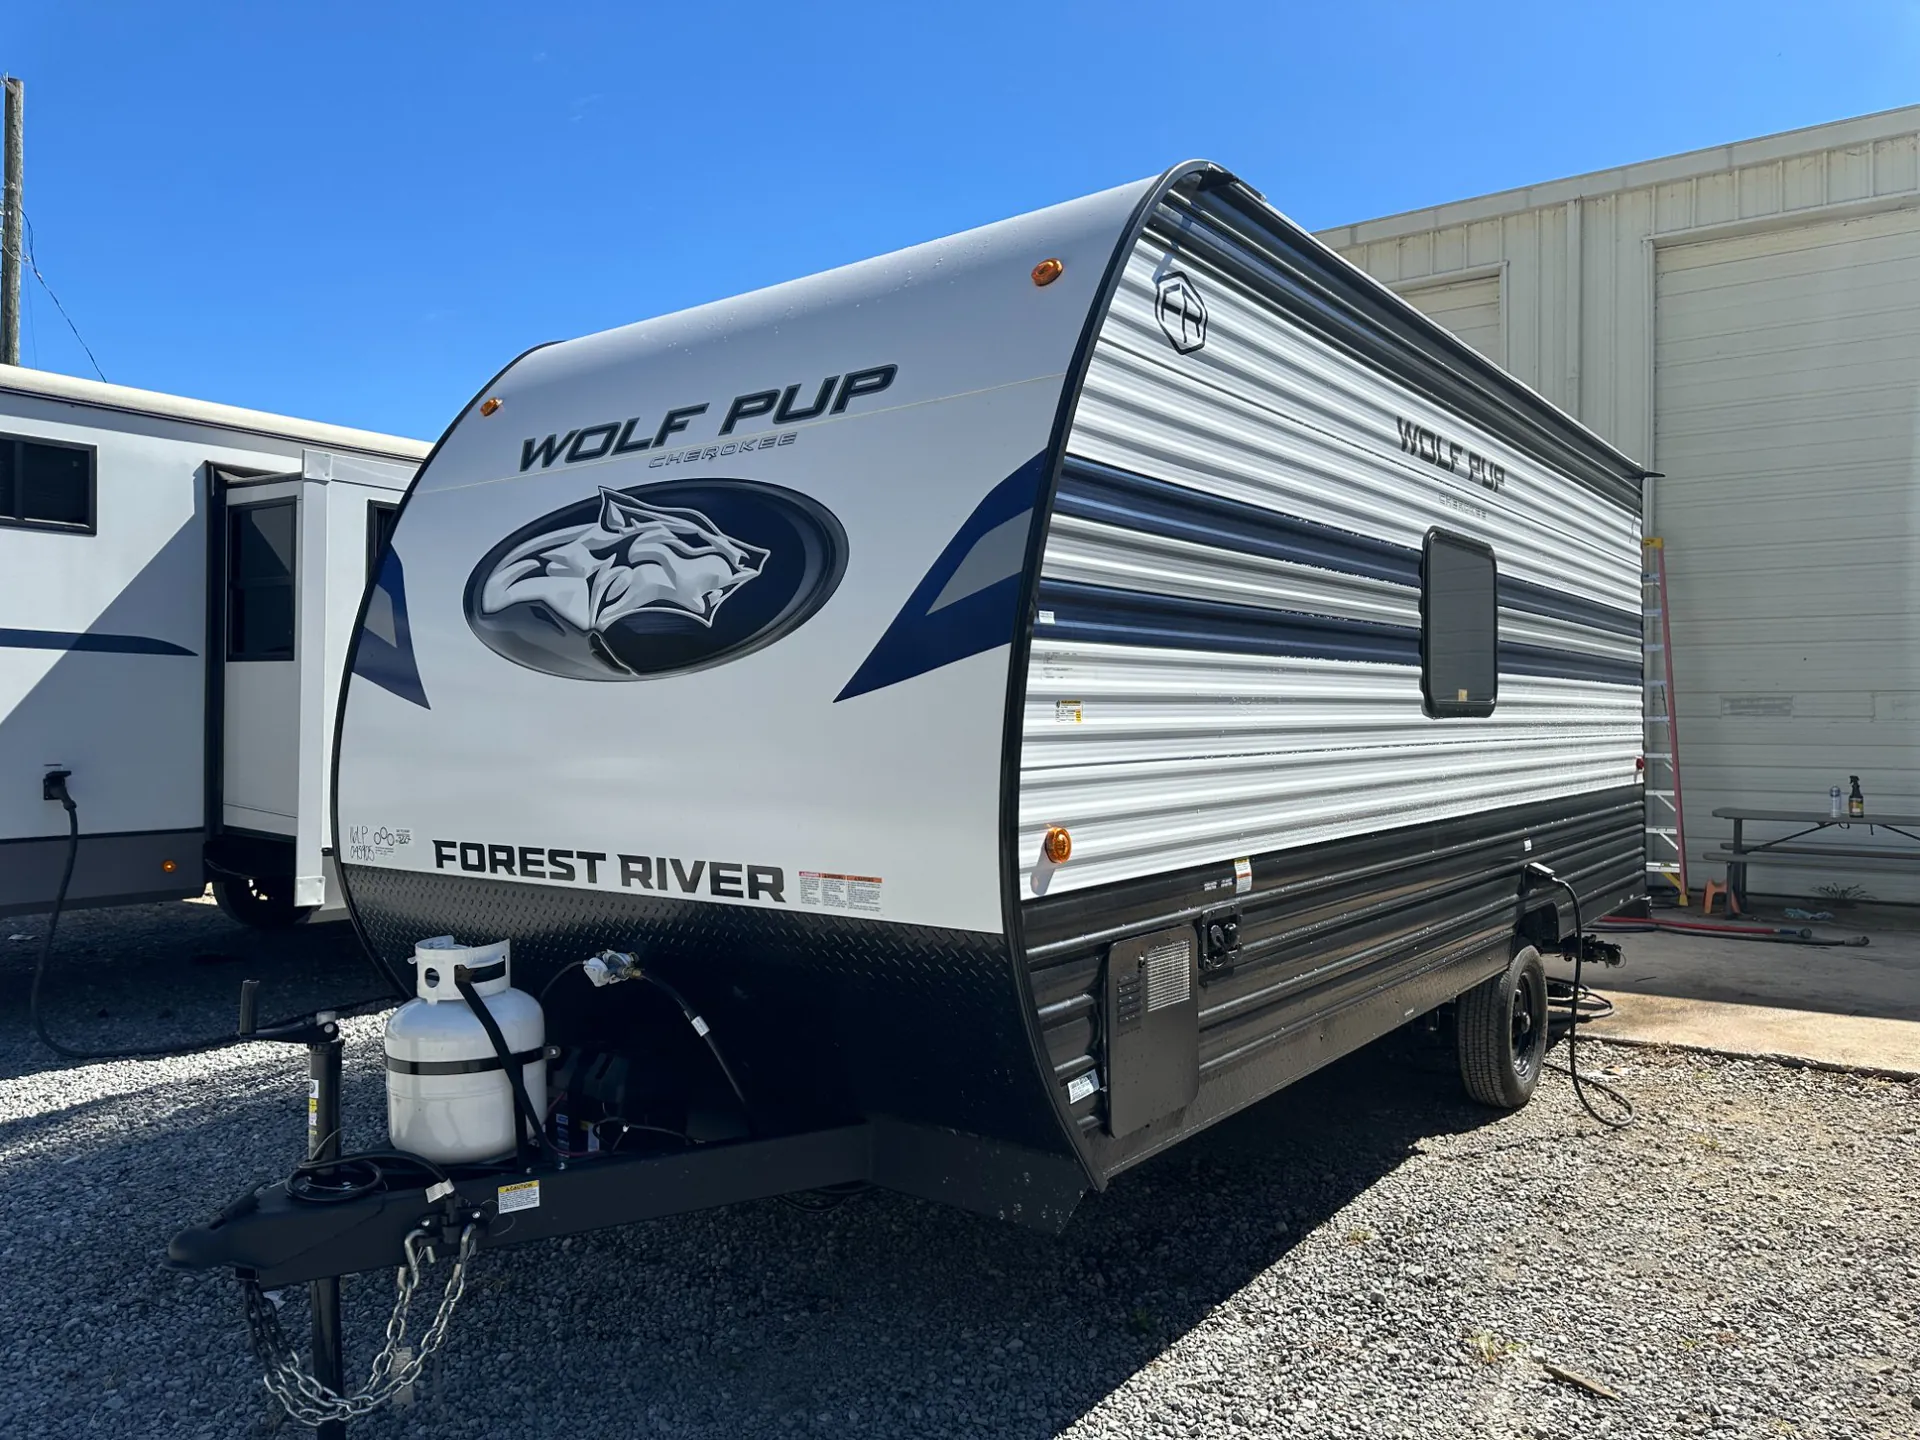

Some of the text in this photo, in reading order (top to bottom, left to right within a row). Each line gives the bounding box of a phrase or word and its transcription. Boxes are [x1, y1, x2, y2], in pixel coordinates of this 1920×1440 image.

[519, 364, 899, 472] WOLF PUP
[648, 431, 798, 469] CHEROKEE
[1396, 415, 1505, 493] WOLF PUP
[431, 839, 607, 884] FOREST
[616, 853, 787, 903] RIVER
